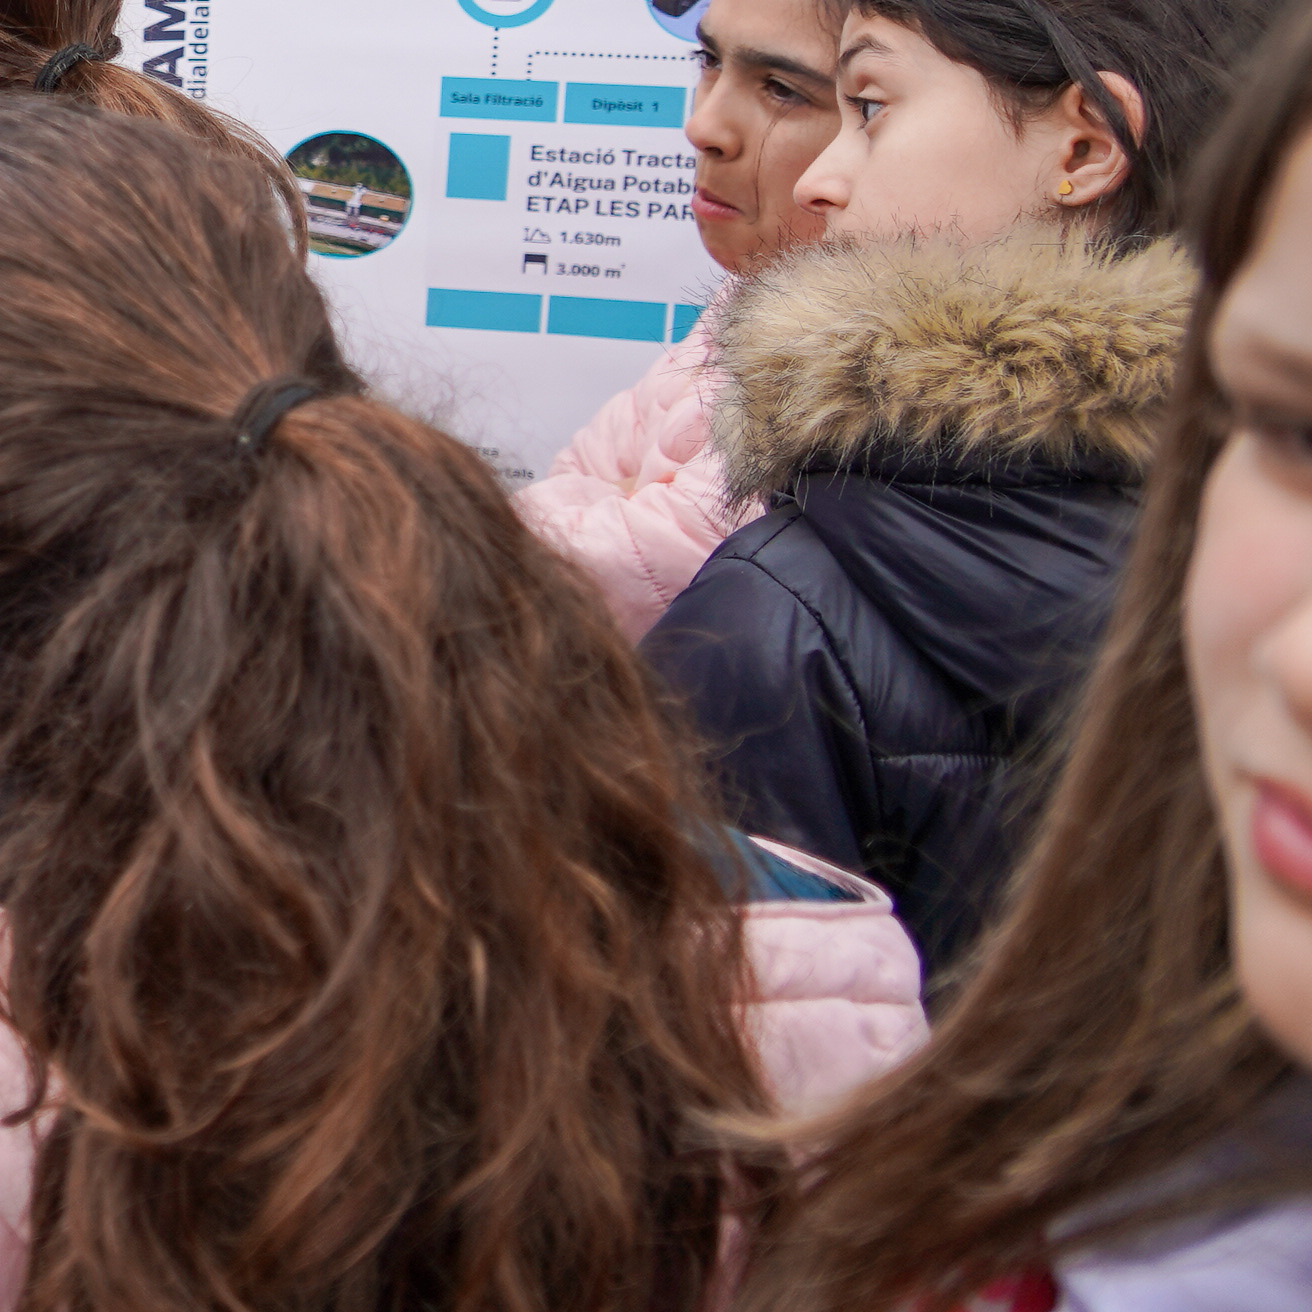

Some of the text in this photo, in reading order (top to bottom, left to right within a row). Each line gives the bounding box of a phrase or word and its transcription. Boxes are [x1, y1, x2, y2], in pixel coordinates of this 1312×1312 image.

[450, 91, 544, 108] Sala Filtració
[591, 98, 660, 114] Dipòsit 1
[529, 144, 697, 170] Estació Tracta
[528, 170, 616, 193] d'Aigua
[526, 196, 695, 221] ETAP LES PAR
[560, 231, 621, 246] 1.630m
[556, 263, 600, 277] 3.000
